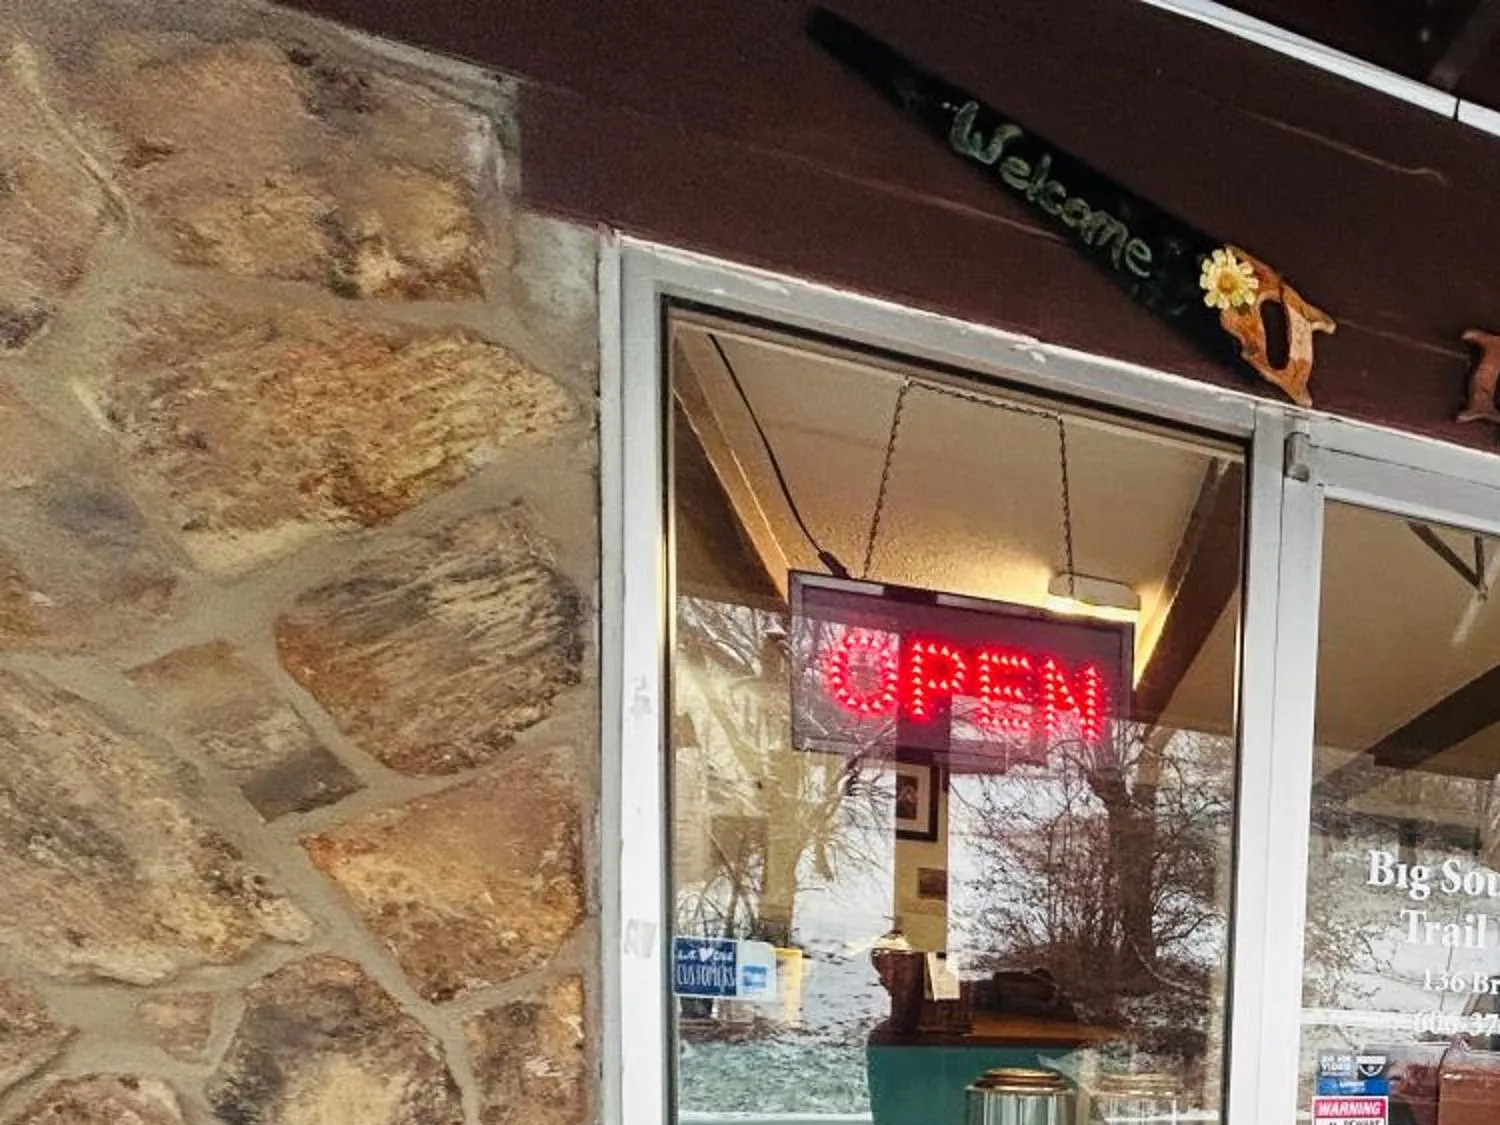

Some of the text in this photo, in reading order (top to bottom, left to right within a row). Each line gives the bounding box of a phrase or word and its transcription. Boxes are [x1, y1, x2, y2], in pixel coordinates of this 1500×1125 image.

[949, 101, 1154, 278] Welcome
[826, 631, 1104, 744] OPEN
[1366, 849, 1431, 901] Big
[1399, 909, 1488, 950] Trail
[1318, 1101, 1381, 1117] WARNING
